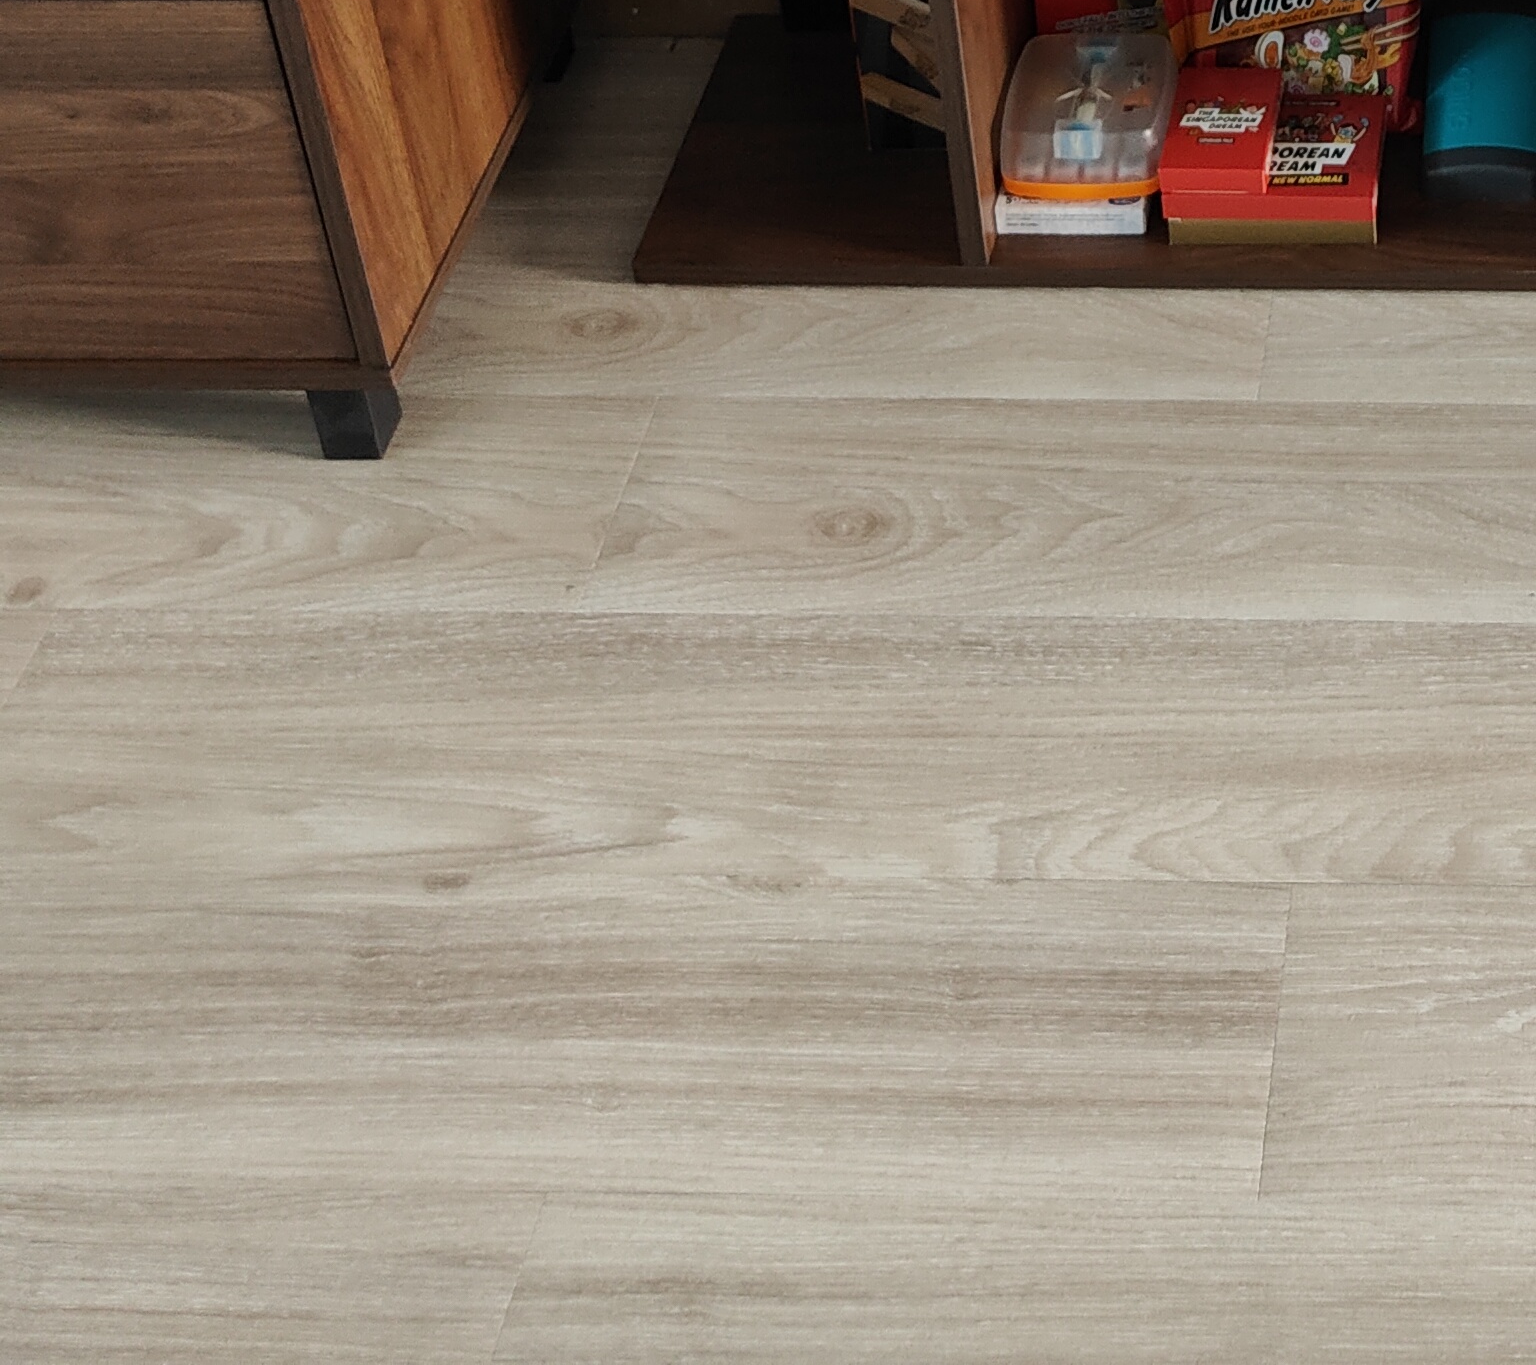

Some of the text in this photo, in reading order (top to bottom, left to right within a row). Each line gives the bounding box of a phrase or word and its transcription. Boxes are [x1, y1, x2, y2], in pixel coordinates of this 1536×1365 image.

[1310, 10, 1328, 18] CARD
[1272, 174, 1344, 184] NEW NORMAL
